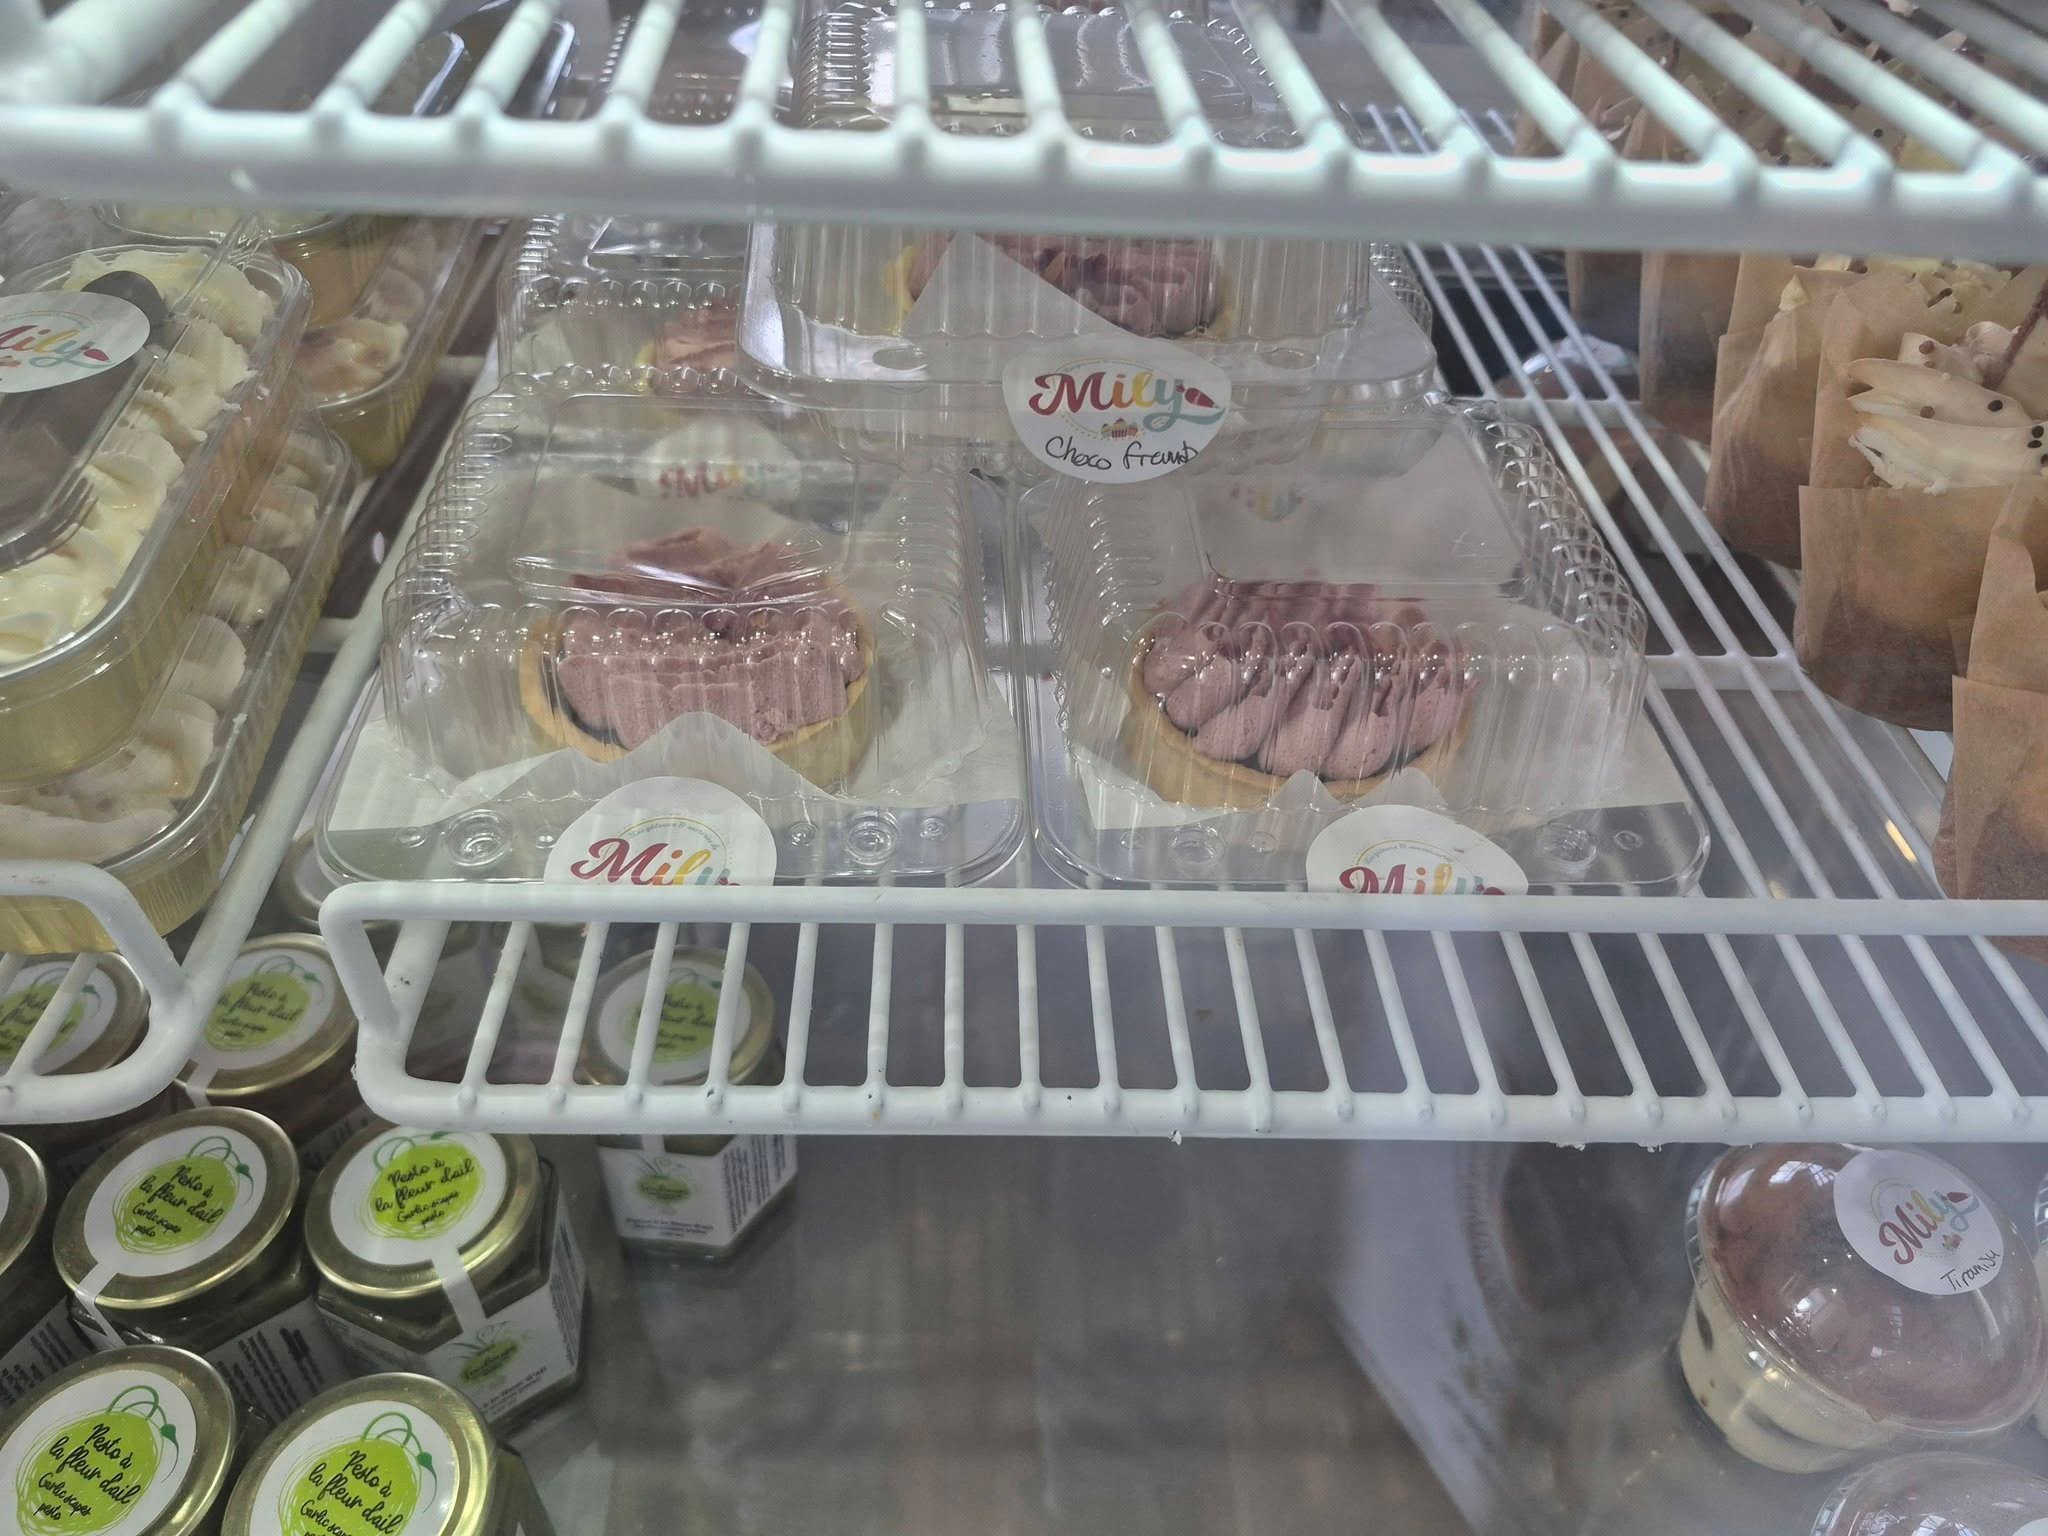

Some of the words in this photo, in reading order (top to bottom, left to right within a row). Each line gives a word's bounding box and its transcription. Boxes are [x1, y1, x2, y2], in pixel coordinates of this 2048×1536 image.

[1029, 371, 1225, 432] Mily
[1045, 437, 1112, 471] Choco
[140, 1175, 156, 1193] la
[169, 1165, 203, 1192] Pesto
[387, 1165, 430, 1188] Pesto
[147, 1182, 187, 1208] fleur
[375, 1196, 393, 1212] la
[395, 1180, 435, 1209] fleur
[1878, 1189, 1980, 1265] Mily
[49, 1436, 70, 1460] la
[84, 1423, 122, 1459] Pesto
[119, 1452, 134, 1469] à
[55, 1445, 102, 1480] fleur
[308, 1462, 327, 1487] la
[342, 1450, 380, 1488] Pesto
[379, 1480, 393, 1498] à
[38, 1472, 68, 1499] Garlic
[63, 1494, 92, 1517] scapes
[316, 1472, 363, 1509] fleur
[33, 1502, 62, 1520] pesto
[300, 1499, 330, 1527] Garlic
